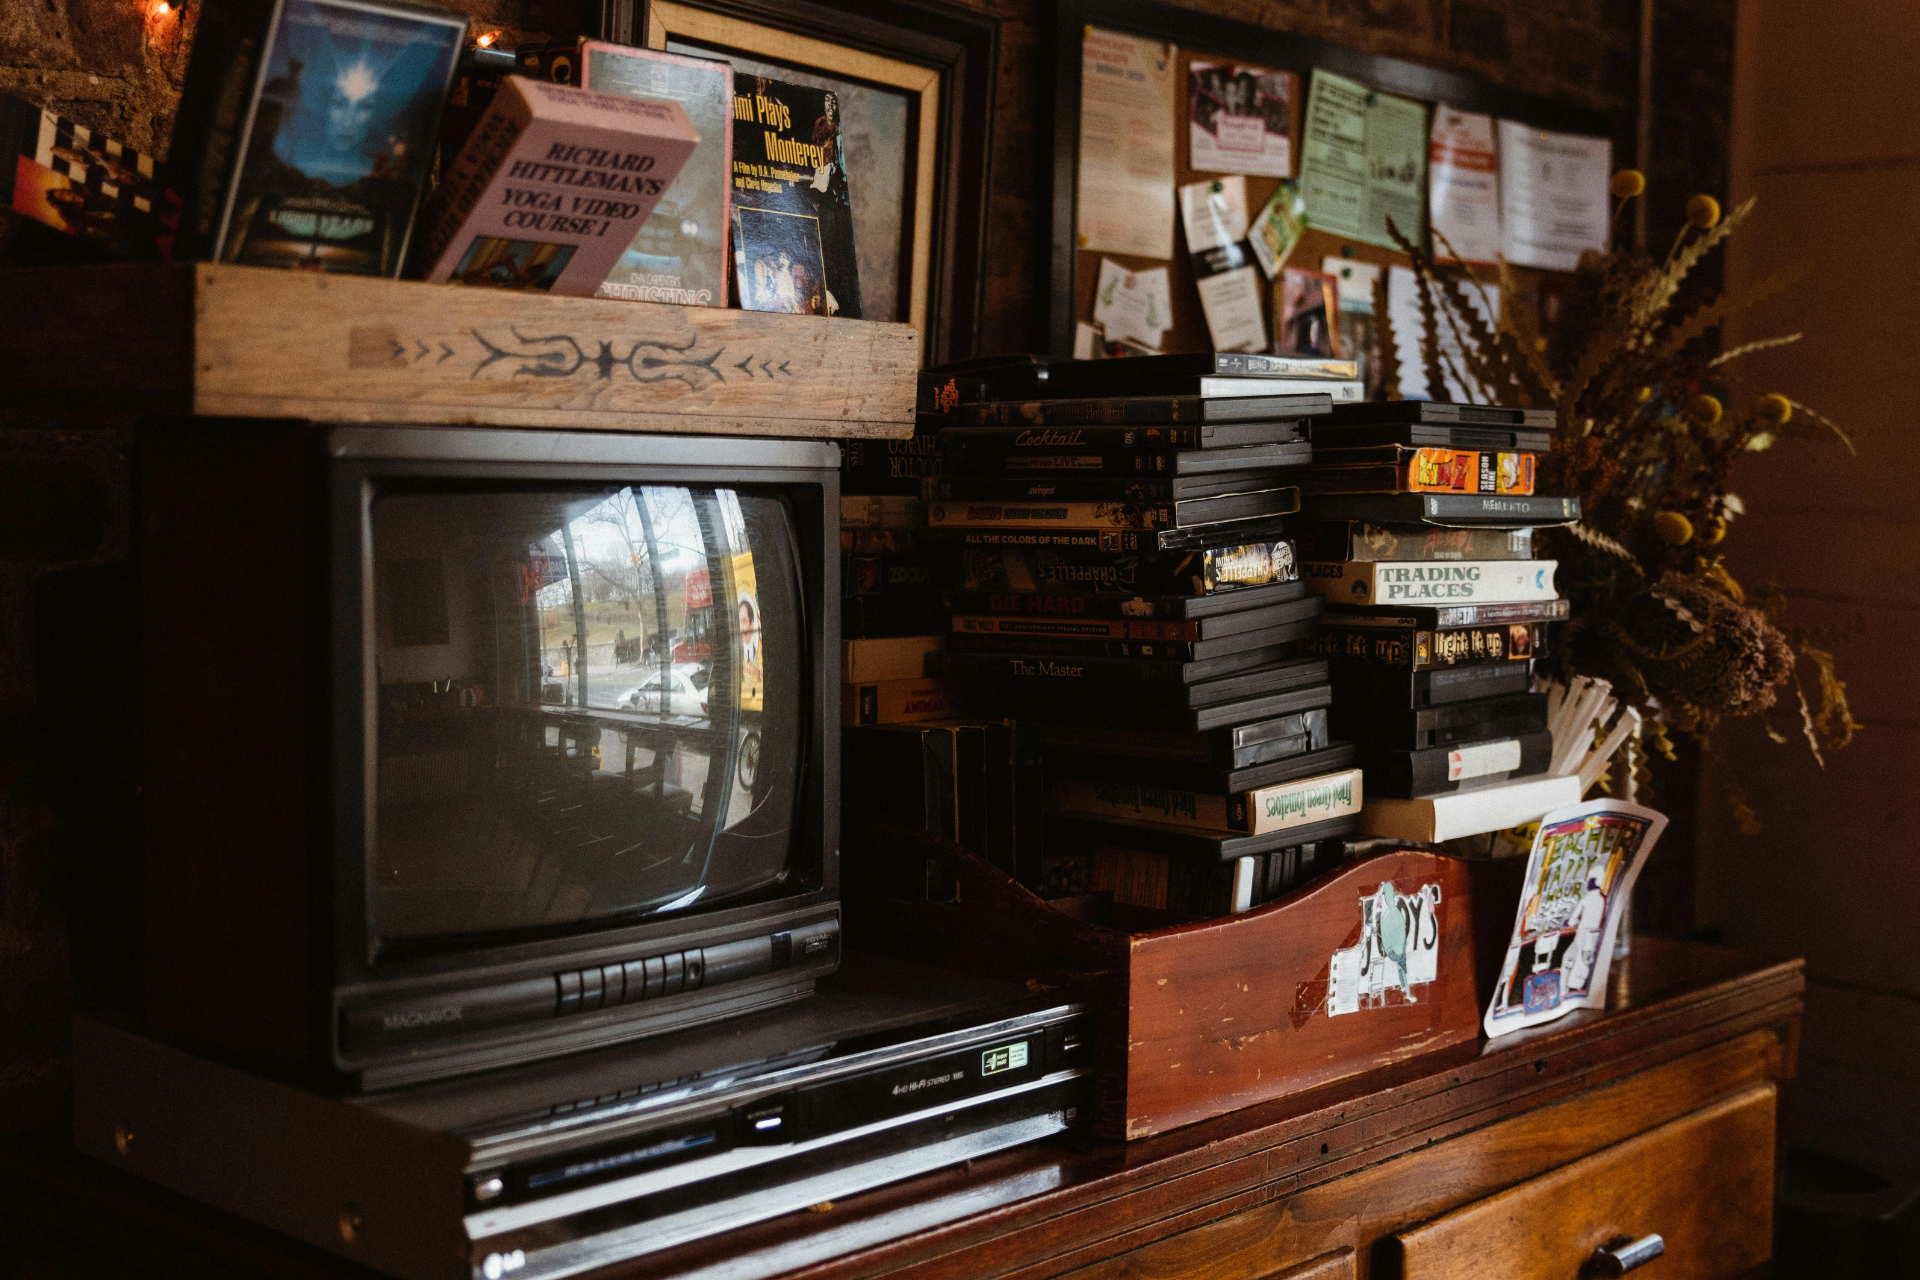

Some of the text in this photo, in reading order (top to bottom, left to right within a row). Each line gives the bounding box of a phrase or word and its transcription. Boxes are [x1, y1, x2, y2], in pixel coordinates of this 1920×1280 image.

[733, 91, 791, 131] imi Plays
[546, 143, 655, 173] RICHARD
[764, 131, 824, 174] Monterey
[738, 162, 750, 175] Film
[751, 164, 758, 177] by
[735, 177, 745, 188] and
[745, 178, 760, 191] Chris
[502, 188, 640, 220] YOGA VIDEO
[503, 210, 597, 236] COURSE
[1248, 359, 1267, 370] BEING
[1085, 403, 1104, 420] Holy
[1104, 403, 1125, 420] Grail
[1015, 429, 1086, 446] Cocktail
[890, 457, 943, 478] DOCTOR
[1054, 457, 1077, 467] LIVE
[1480, 456, 1489, 490] SEASON
[1482, 499, 1530, 513] MEMENTO
[966, 534, 1097, 546] ALL THE COLORS OF THE DARK
[1303, 564, 1343, 579] PLACES
[1379, 567, 1481, 582] TRADING
[1387, 583, 1474, 599] PLACES
[990, 594, 1085, 614] DIE HARD
[963, 619, 977, 631] FREE
[978, 619, 994, 632] WILLY
[1008, 641, 1024, 650] PET
[1026, 642, 1073, 652] DETECTIVE
[1375, 639, 1402, 662] up
[1434, 630, 1503, 660] light it up
[1010, 660, 1083, 677] The Master
[1096, 784, 1196, 820] Tomatoes Green Fried
[1266, 779, 1352, 820] Tomatoes Green Fried
[1544, 823, 1638, 864] TEACHER
[1541, 856, 1598, 893] HAPPY
[1546, 881, 1582, 904] HOUR
[927, 1073, 950, 1087] STEREO
